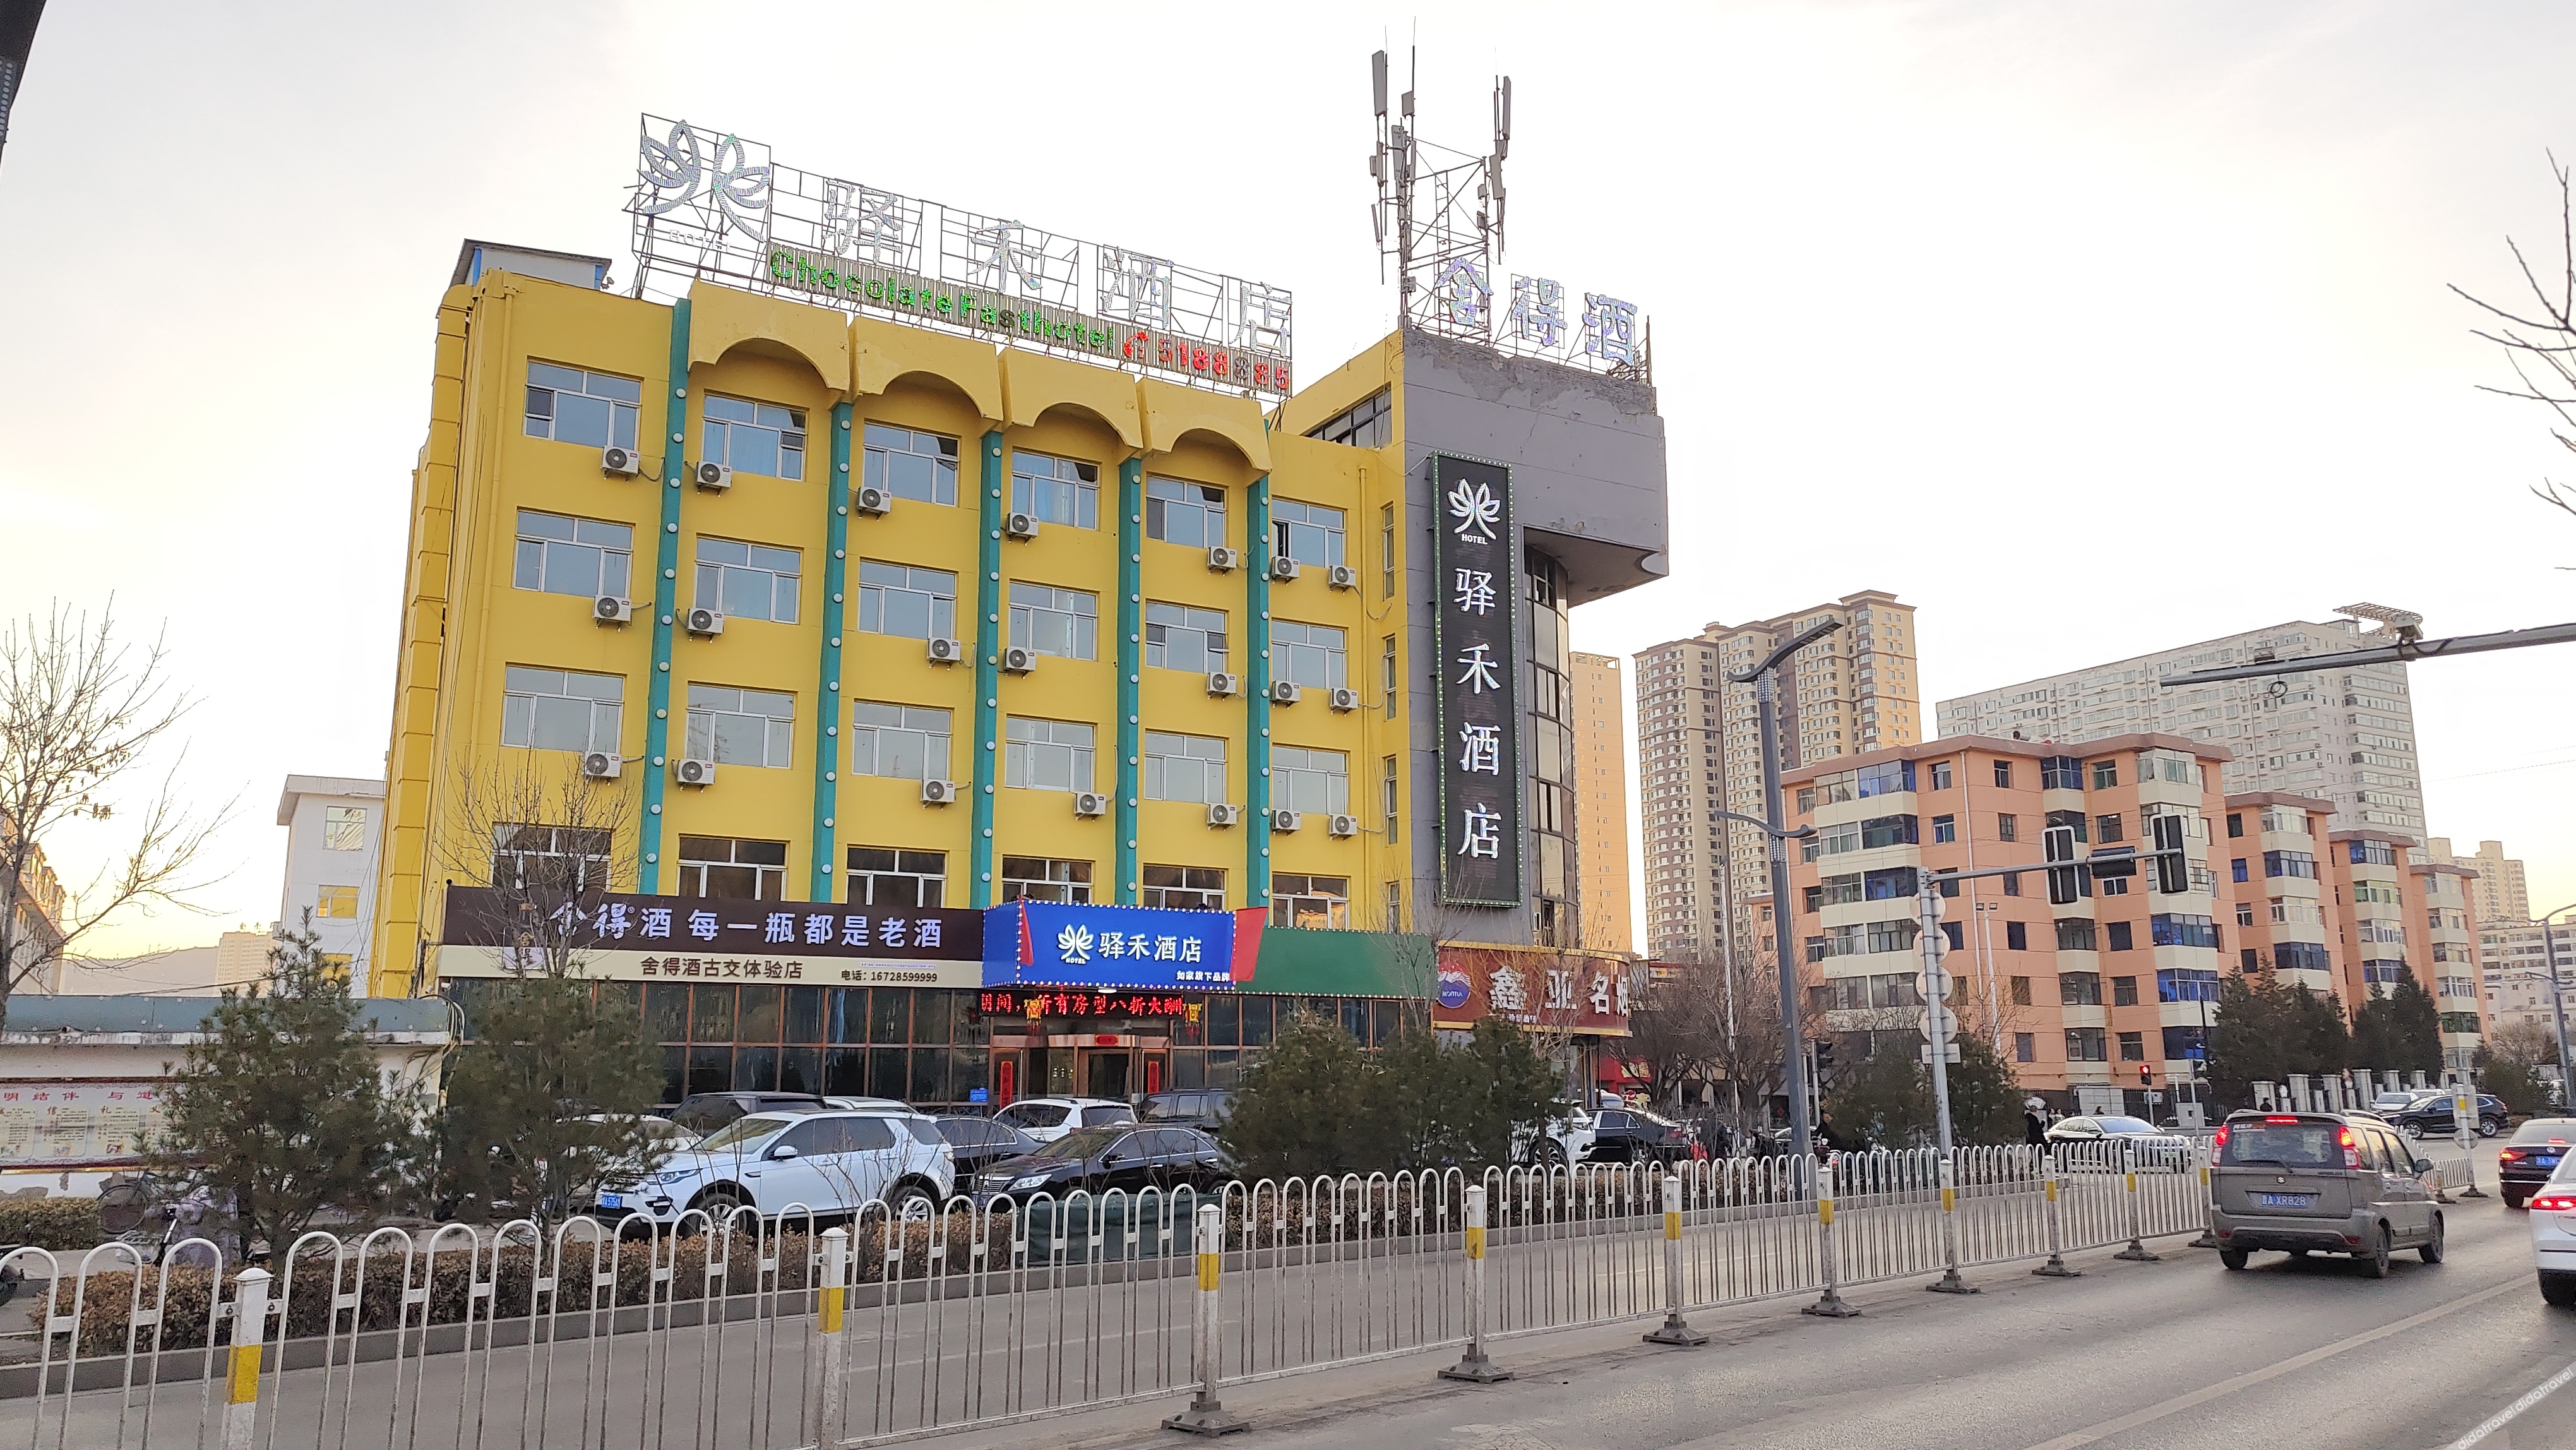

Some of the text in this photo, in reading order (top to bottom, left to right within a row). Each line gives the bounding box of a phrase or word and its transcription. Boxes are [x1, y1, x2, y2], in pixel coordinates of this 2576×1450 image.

[822, 178, 1292, 356] 驿禾酒店
[1461, 533, 1488, 545] HOTEL
[1454, 567, 1502, 860] 驿禾酒店
[1097, 932, 1202, 964] 驿禾酒店
[640, 956, 803, 979] 舍得酒古交体验店
[1176, 970, 1231, 983] 如家旗下品牌
